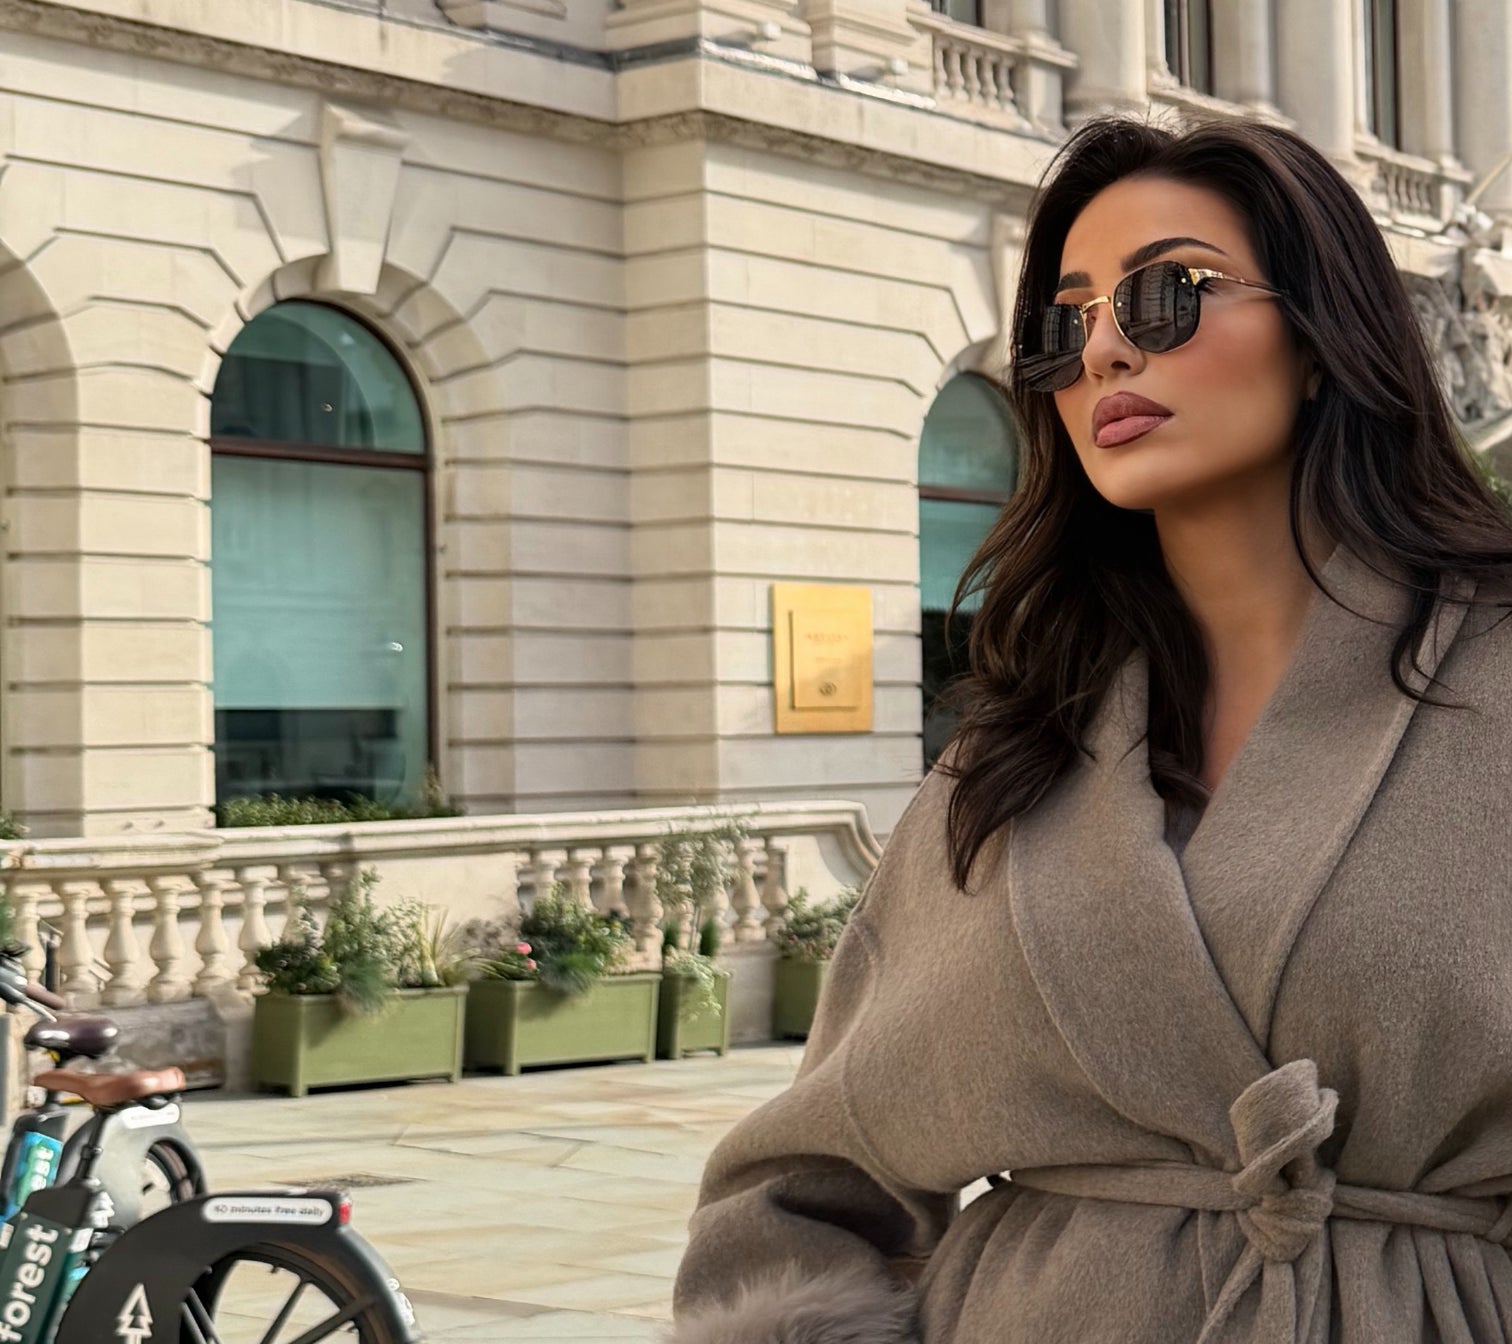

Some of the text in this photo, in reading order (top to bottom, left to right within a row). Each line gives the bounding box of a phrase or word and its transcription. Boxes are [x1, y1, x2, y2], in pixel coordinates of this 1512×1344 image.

[31, 1146, 54, 1192] est
[275, 1205, 297, 1216] free
[0, 1224, 59, 1342] forest
